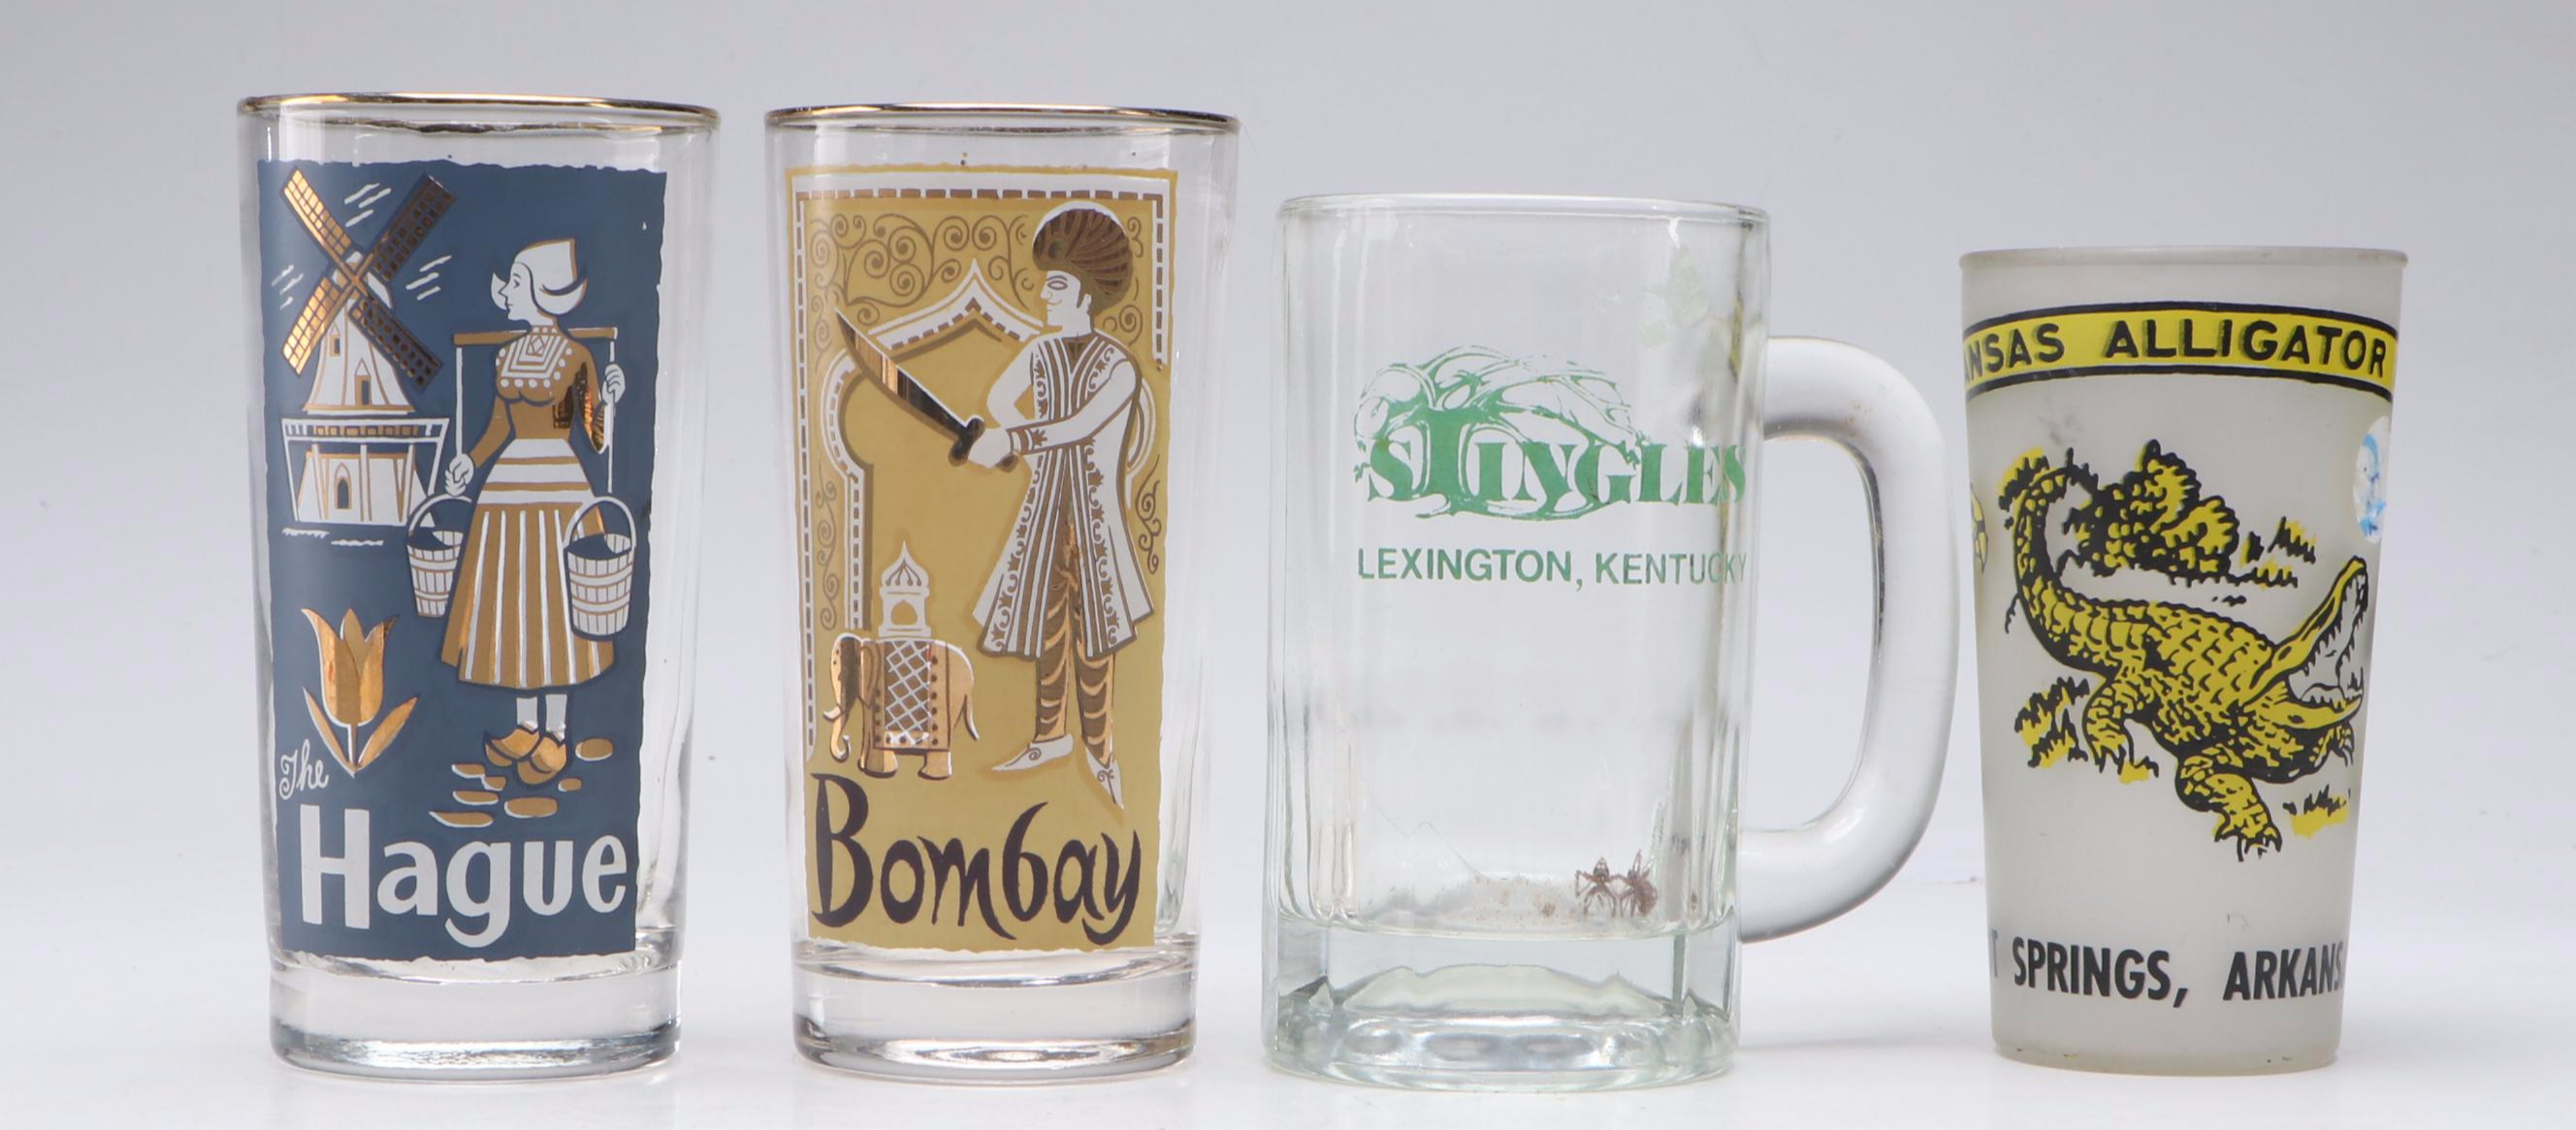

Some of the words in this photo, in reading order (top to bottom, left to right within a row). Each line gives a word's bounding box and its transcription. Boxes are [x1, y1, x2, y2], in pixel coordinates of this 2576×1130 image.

[1965, 322, 2065, 384] NSAS
[2105, 319, 2387, 378] ALLIGATOR
[1358, 547, 1583, 592] LEXINGTON,
[1594, 552, 1747, 585] KENTUCKY
[279, 739, 329, 801] The
[300, 804, 628, 949] Hague
[810, 773, 1142, 946] Bombay
[2012, 936, 2189, 1009] SPRINGS,
[2222, 940, 2343, 1001] ARKANS
